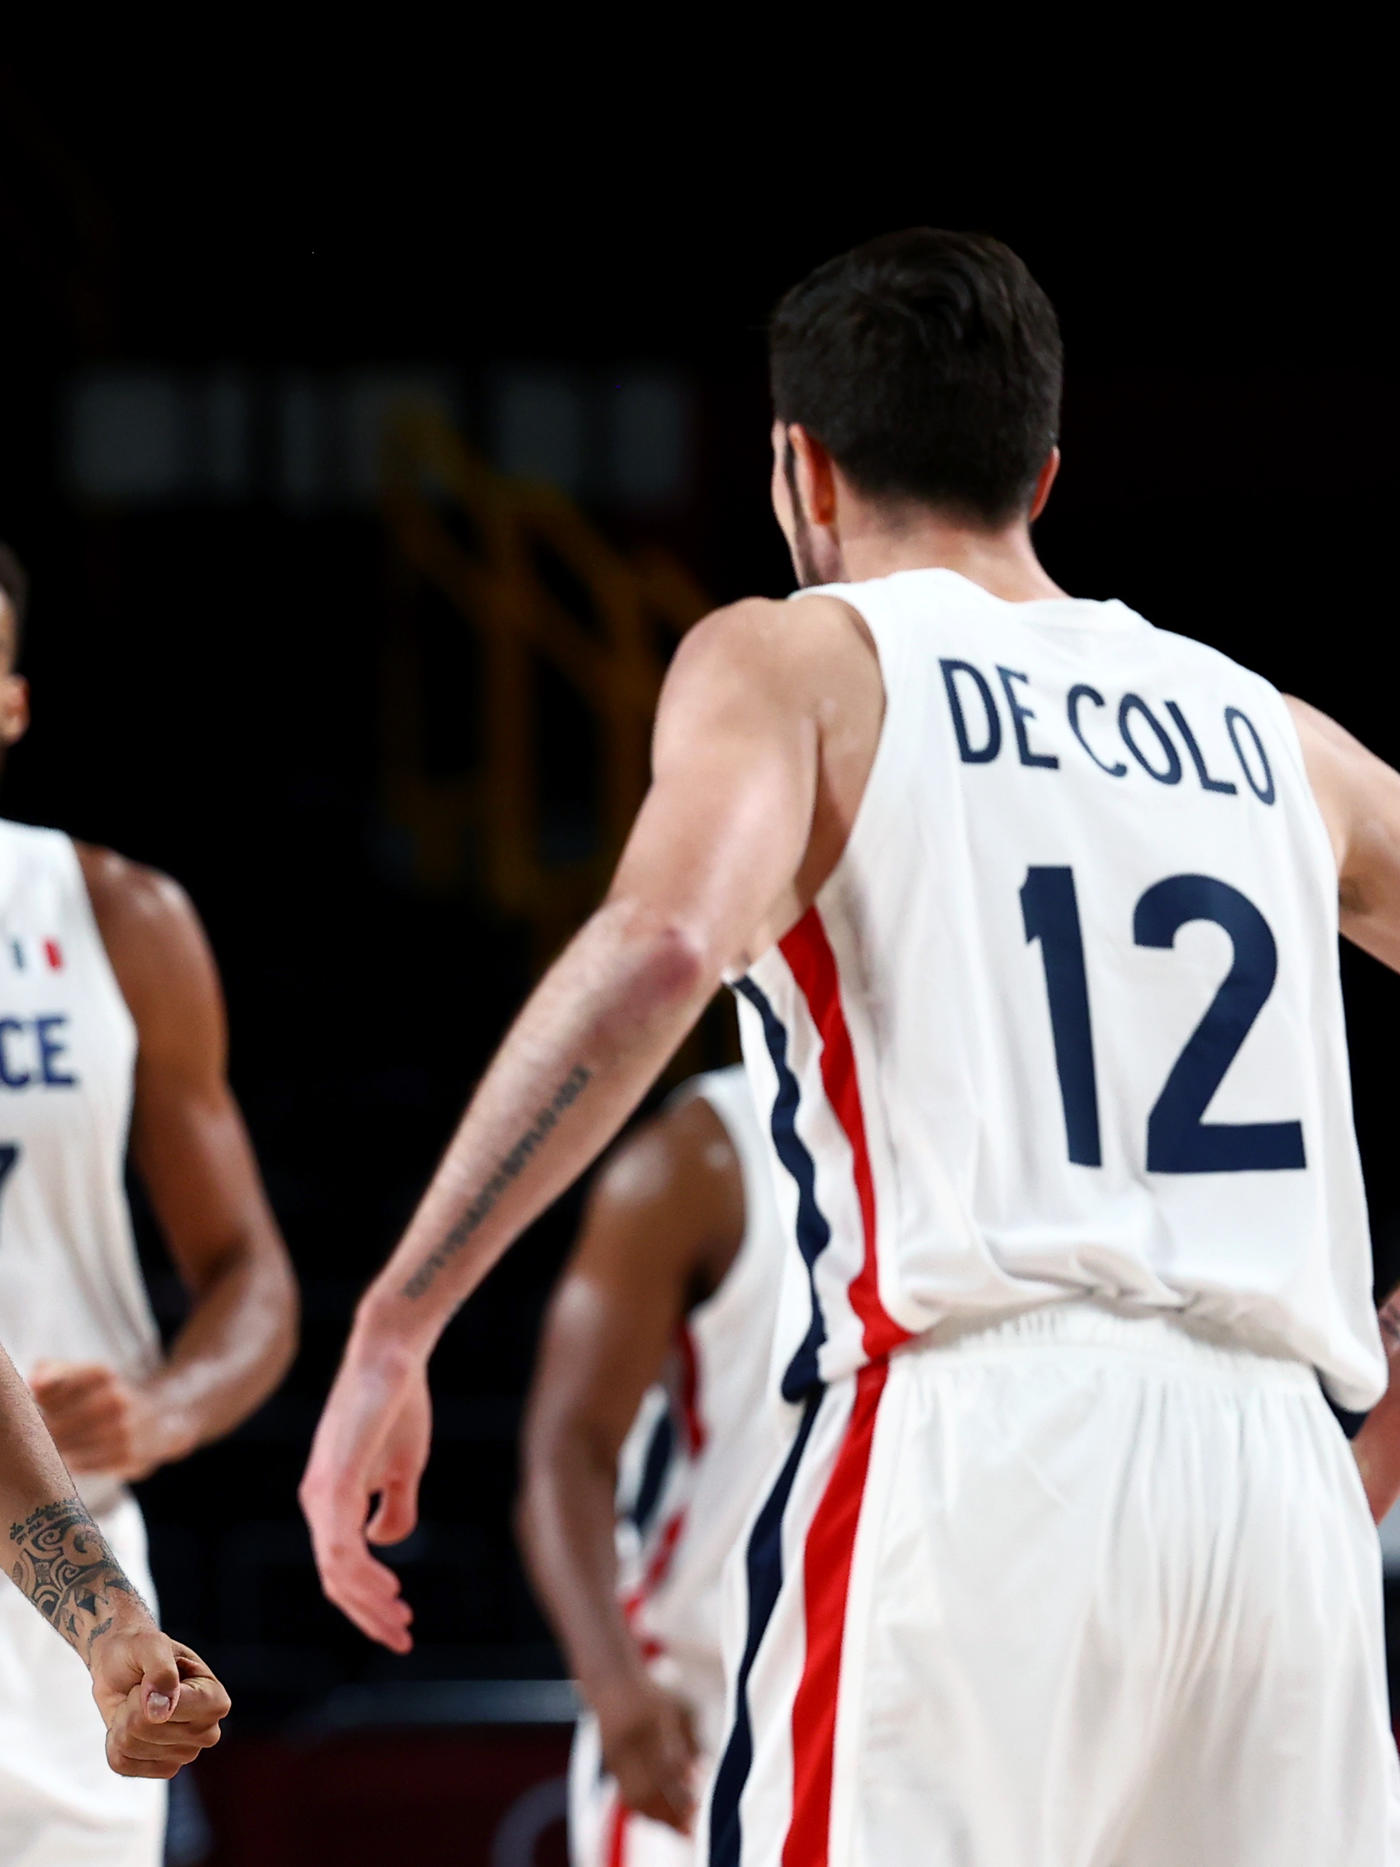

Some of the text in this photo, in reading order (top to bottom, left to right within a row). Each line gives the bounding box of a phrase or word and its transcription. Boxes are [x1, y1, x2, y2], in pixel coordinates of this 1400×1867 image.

[937, 657, 1277, 806] DE COLO
[1019, 865, 1308, 1173] 12
